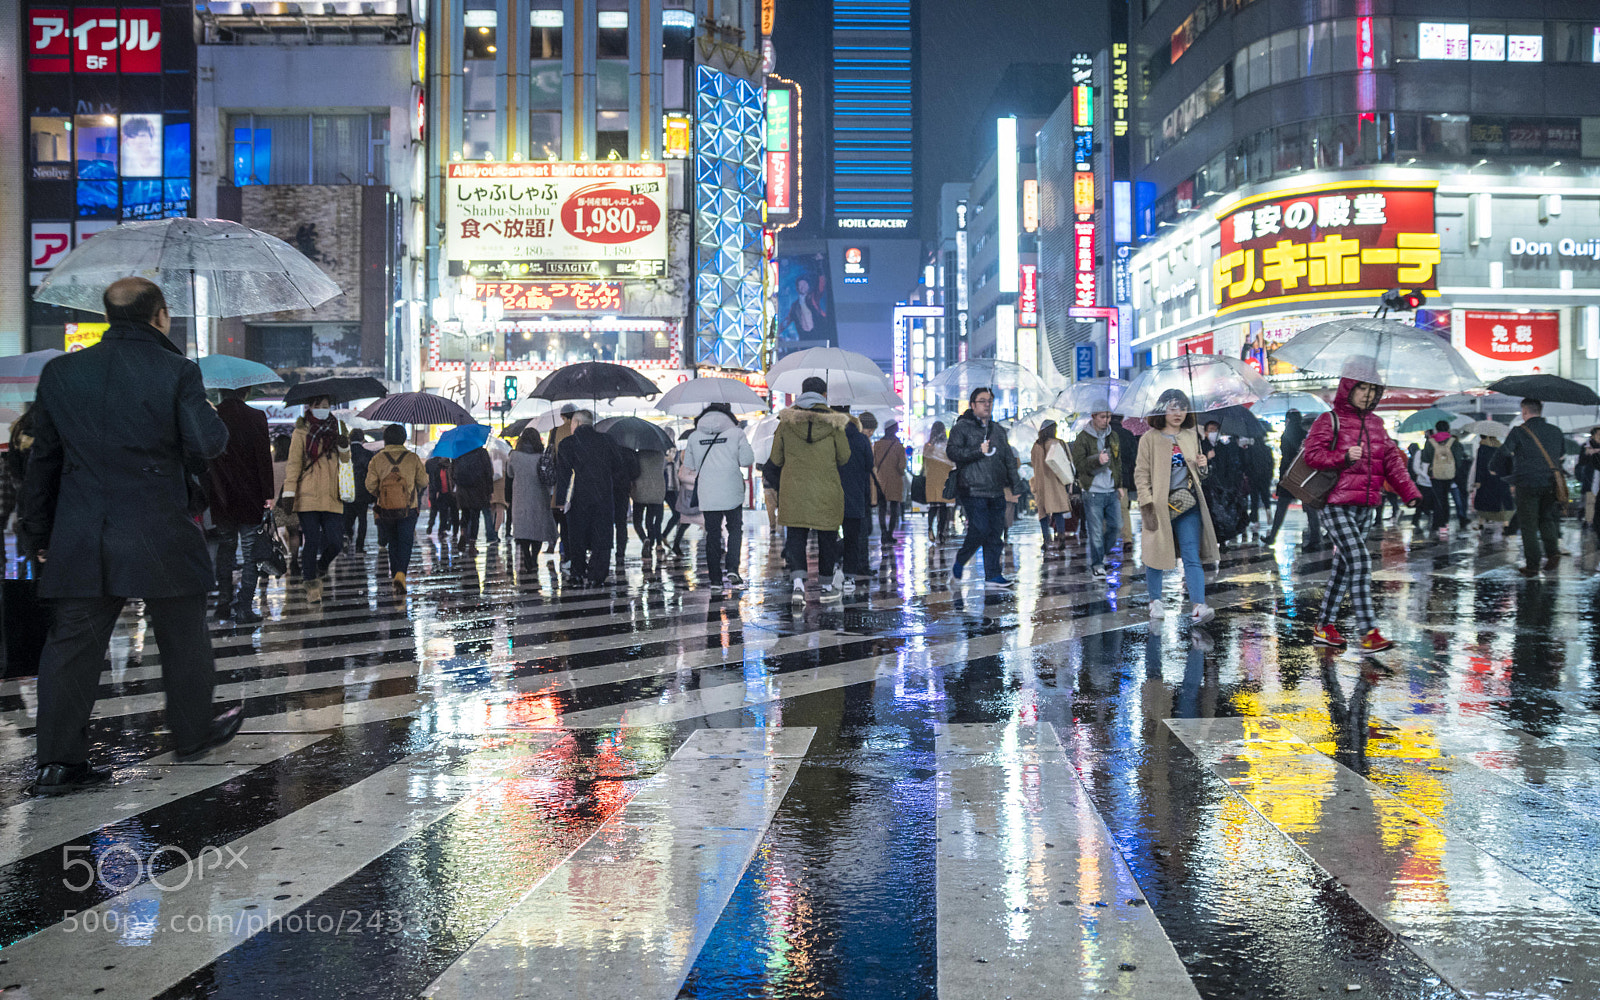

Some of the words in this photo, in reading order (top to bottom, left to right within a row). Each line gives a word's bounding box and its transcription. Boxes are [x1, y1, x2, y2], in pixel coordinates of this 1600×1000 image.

[33, 17, 160, 51] アイフル
[86, 55, 108, 69] 5F
[33, 167, 70, 178] Neolive
[552, 164, 588, 176] buffet
[593, 165, 611, 176] for
[614, 165, 624, 176] 2
[626, 164, 663, 176] hours
[458, 184, 558, 201] しゃぶしゃぶ
[460, 219, 554, 239] 食べ放題!
[573, 207, 635, 236] 1,980
[636, 224, 653, 233] yen
[838, 219, 867, 228] HOTEL
[867, 219, 908, 228] GRACERY
[1510, 237, 1552, 255] Don
[476, 284, 498, 298] 7F
[500, 282, 619, 297] ひょうたん
[1491, 324, 1533, 342] 免税
[1491, 342, 1511, 352] Tax
[1511, 342, 1533, 352] Free
